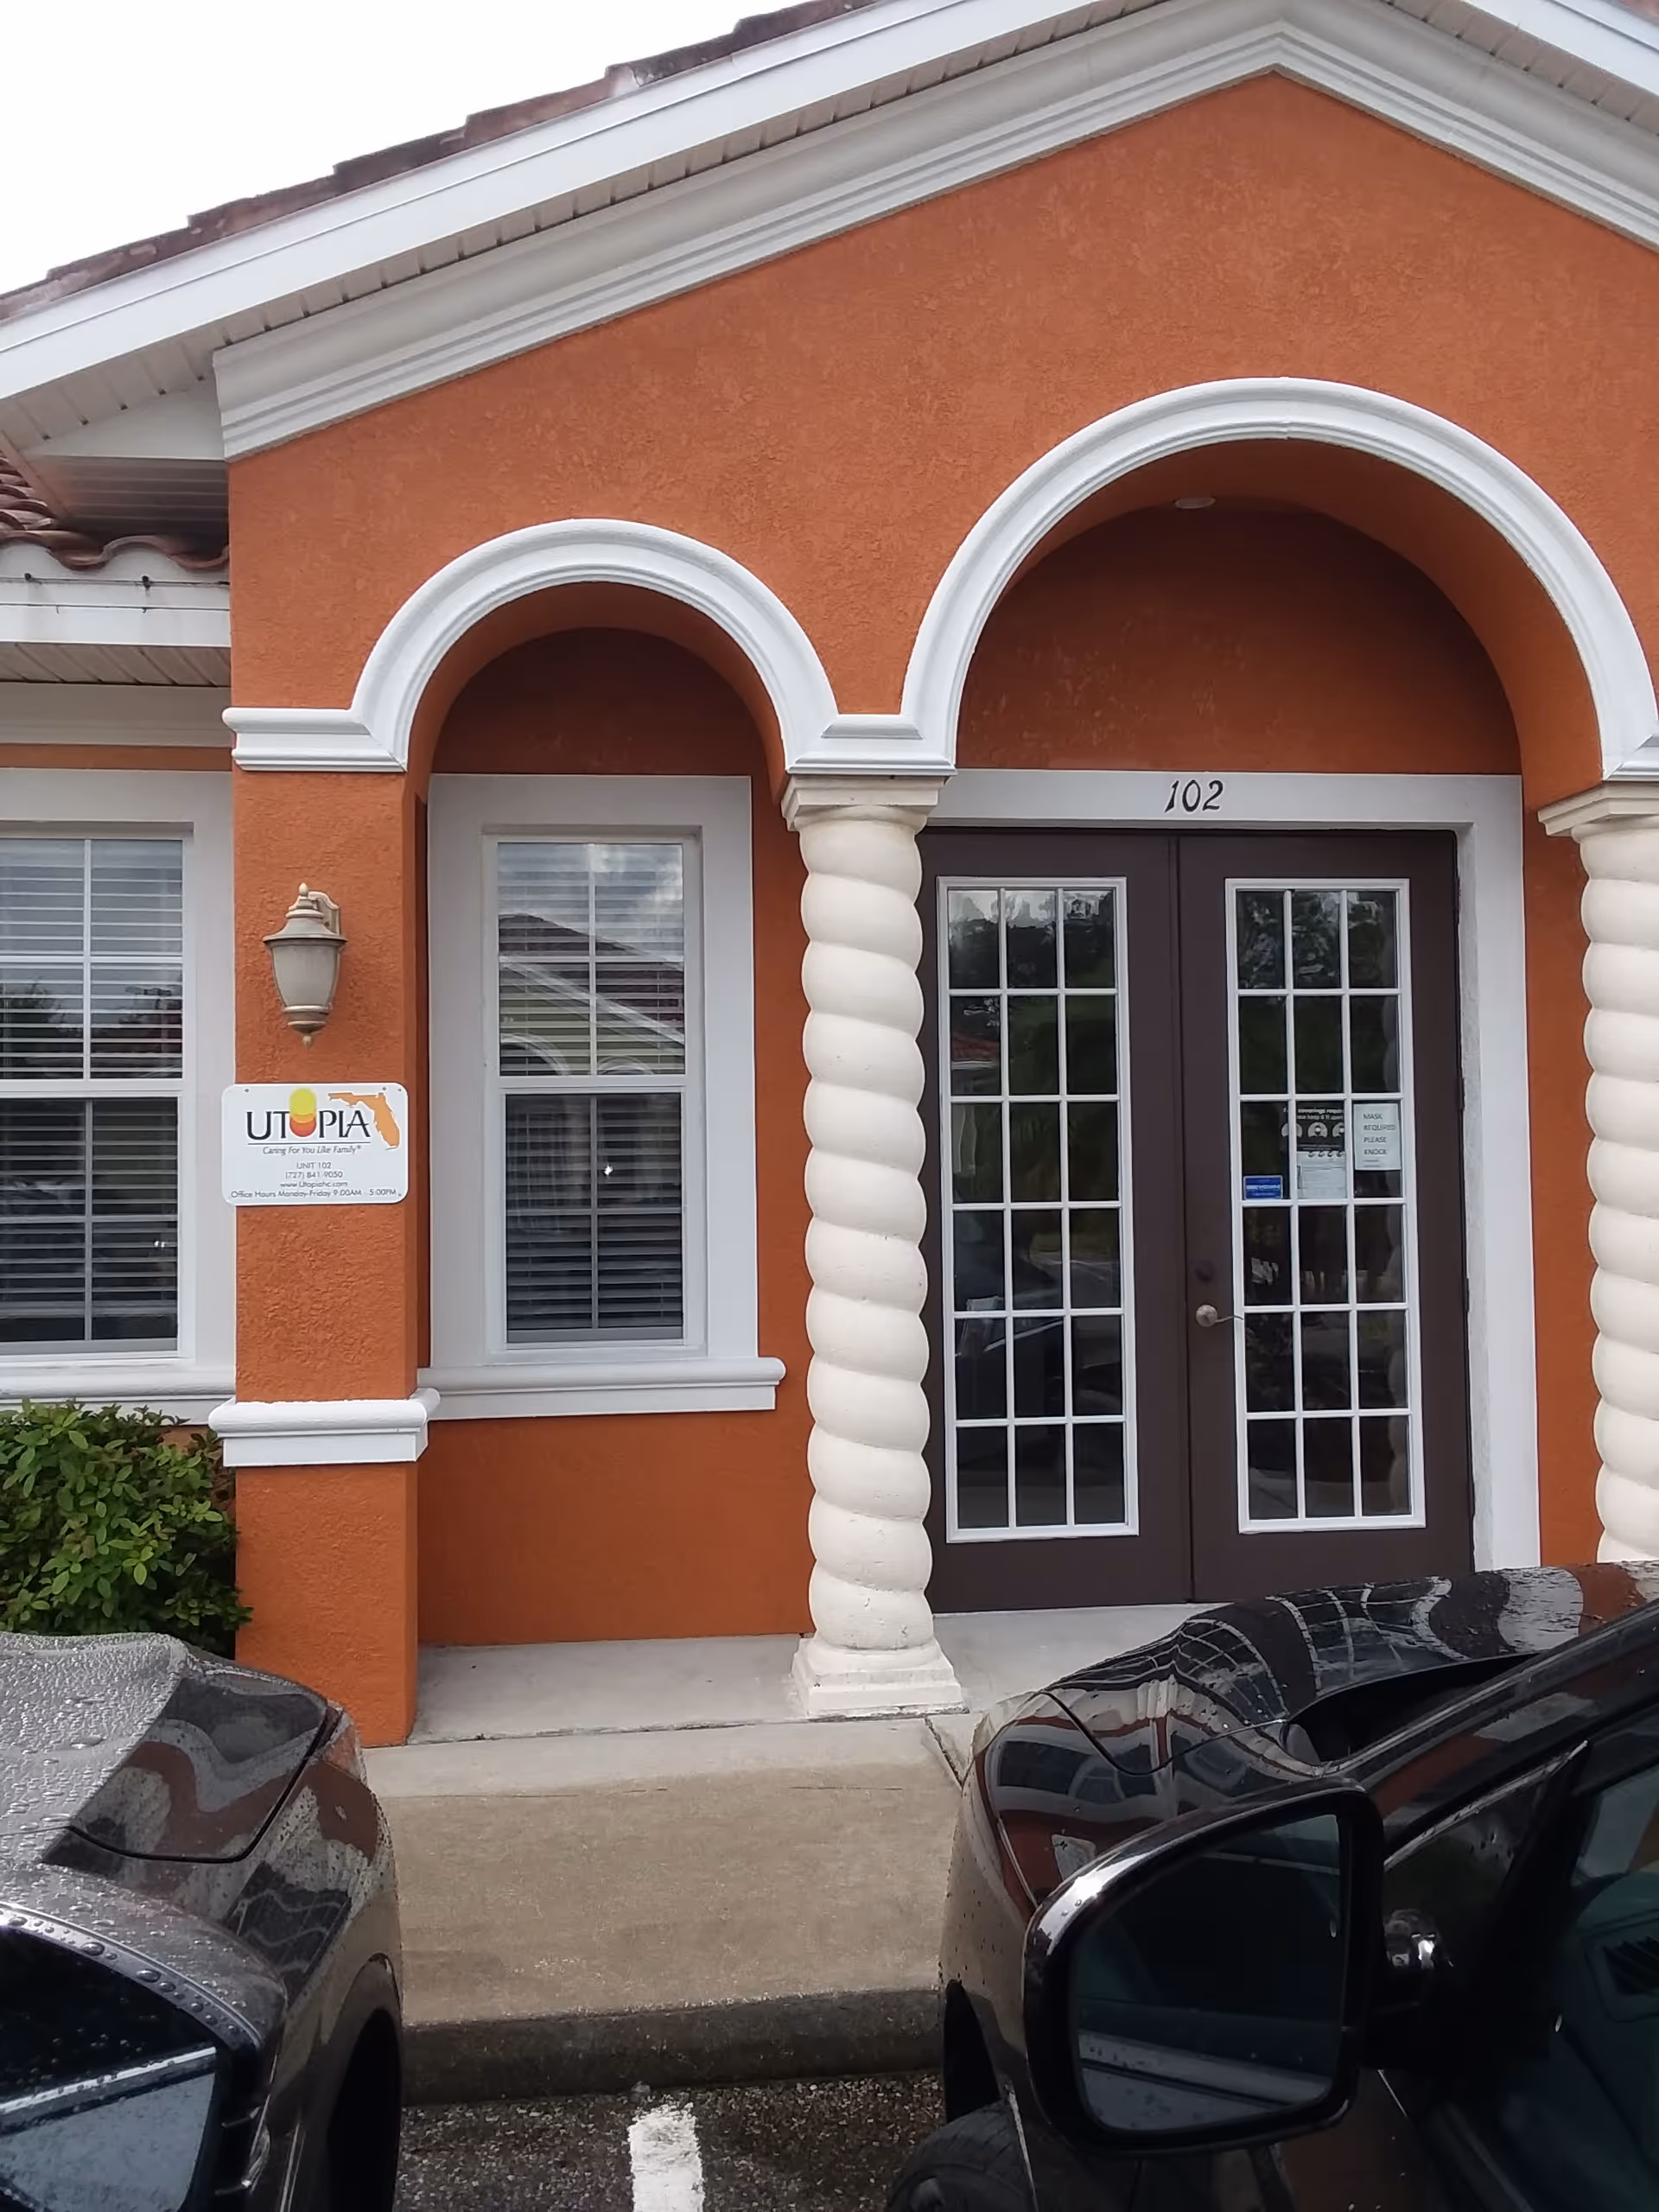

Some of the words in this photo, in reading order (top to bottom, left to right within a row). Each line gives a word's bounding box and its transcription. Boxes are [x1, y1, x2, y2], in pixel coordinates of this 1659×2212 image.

[1165, 779, 1224, 813] 102
[246, 1087, 372, 1141] UTOPIA
[263, 1146, 287, 1156] Caring
[288, 1146, 301, 1154] For
[302, 1146, 315, 1154] You
[316, 1145, 332, 1154] Like
[285, 1171, 304, 1179] (727)
[231, 1190, 253, 1198] Office
